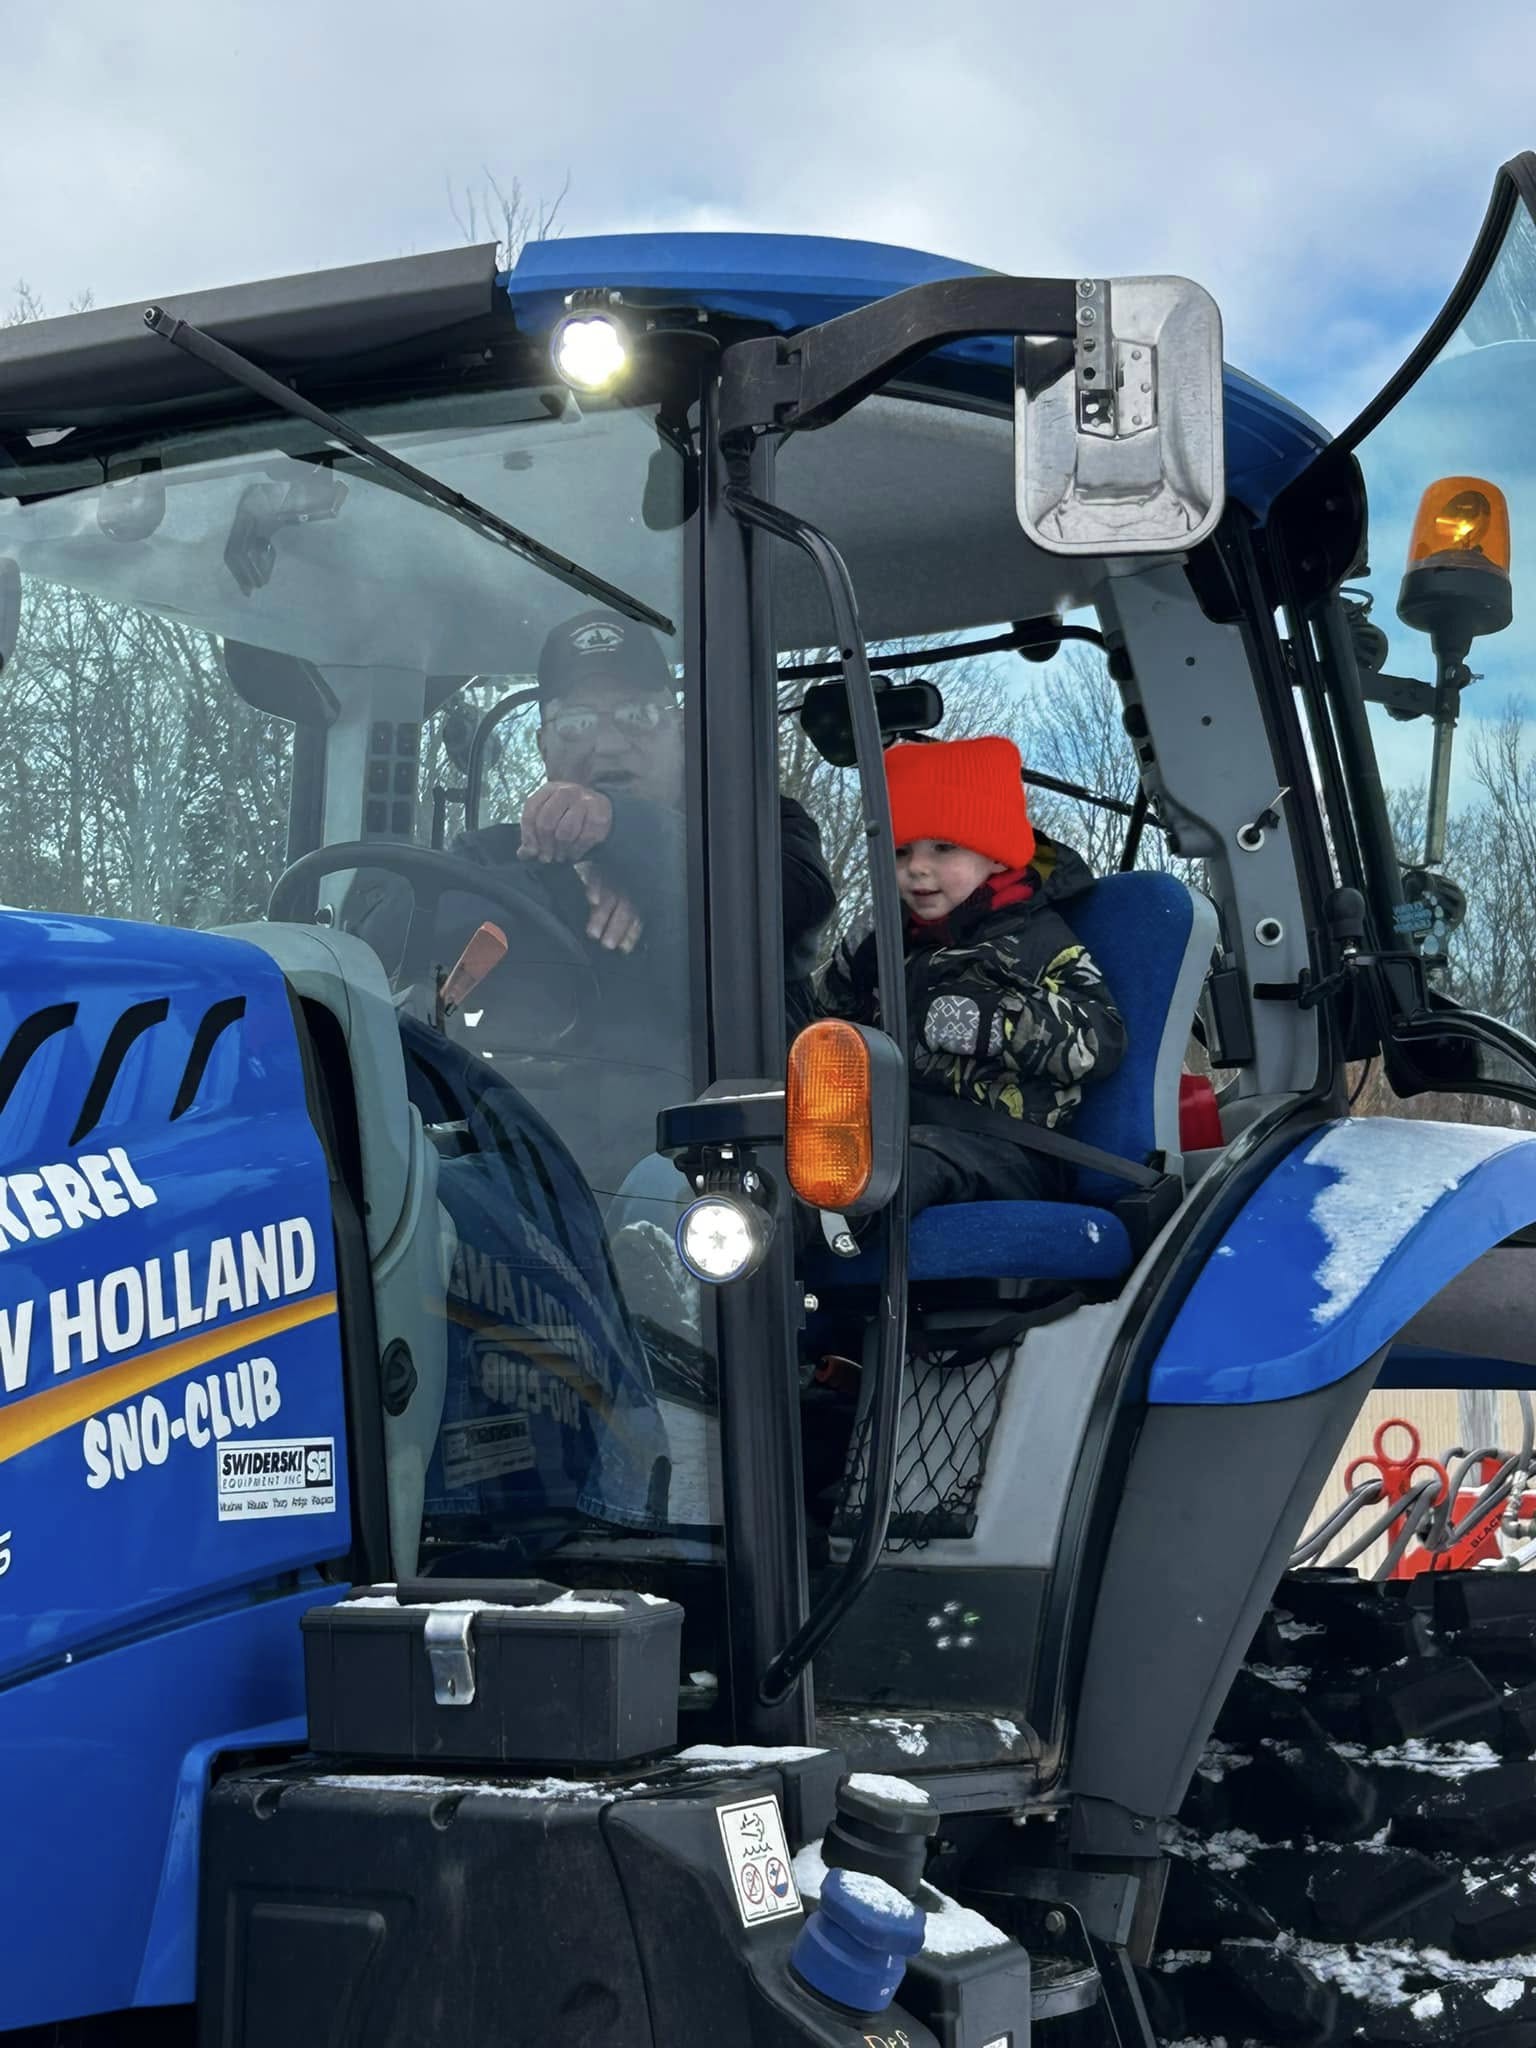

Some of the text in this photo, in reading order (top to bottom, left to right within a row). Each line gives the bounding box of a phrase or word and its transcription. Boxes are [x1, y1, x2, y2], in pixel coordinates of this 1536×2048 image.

[49, 1216, 316, 1375] HOLLAND
[83, 1357, 281, 1489] SNO-CLUB
[222, 1450, 303, 1476] SWIDERSKI
[222, 1474, 302, 1489] EQUIPMENT INC
